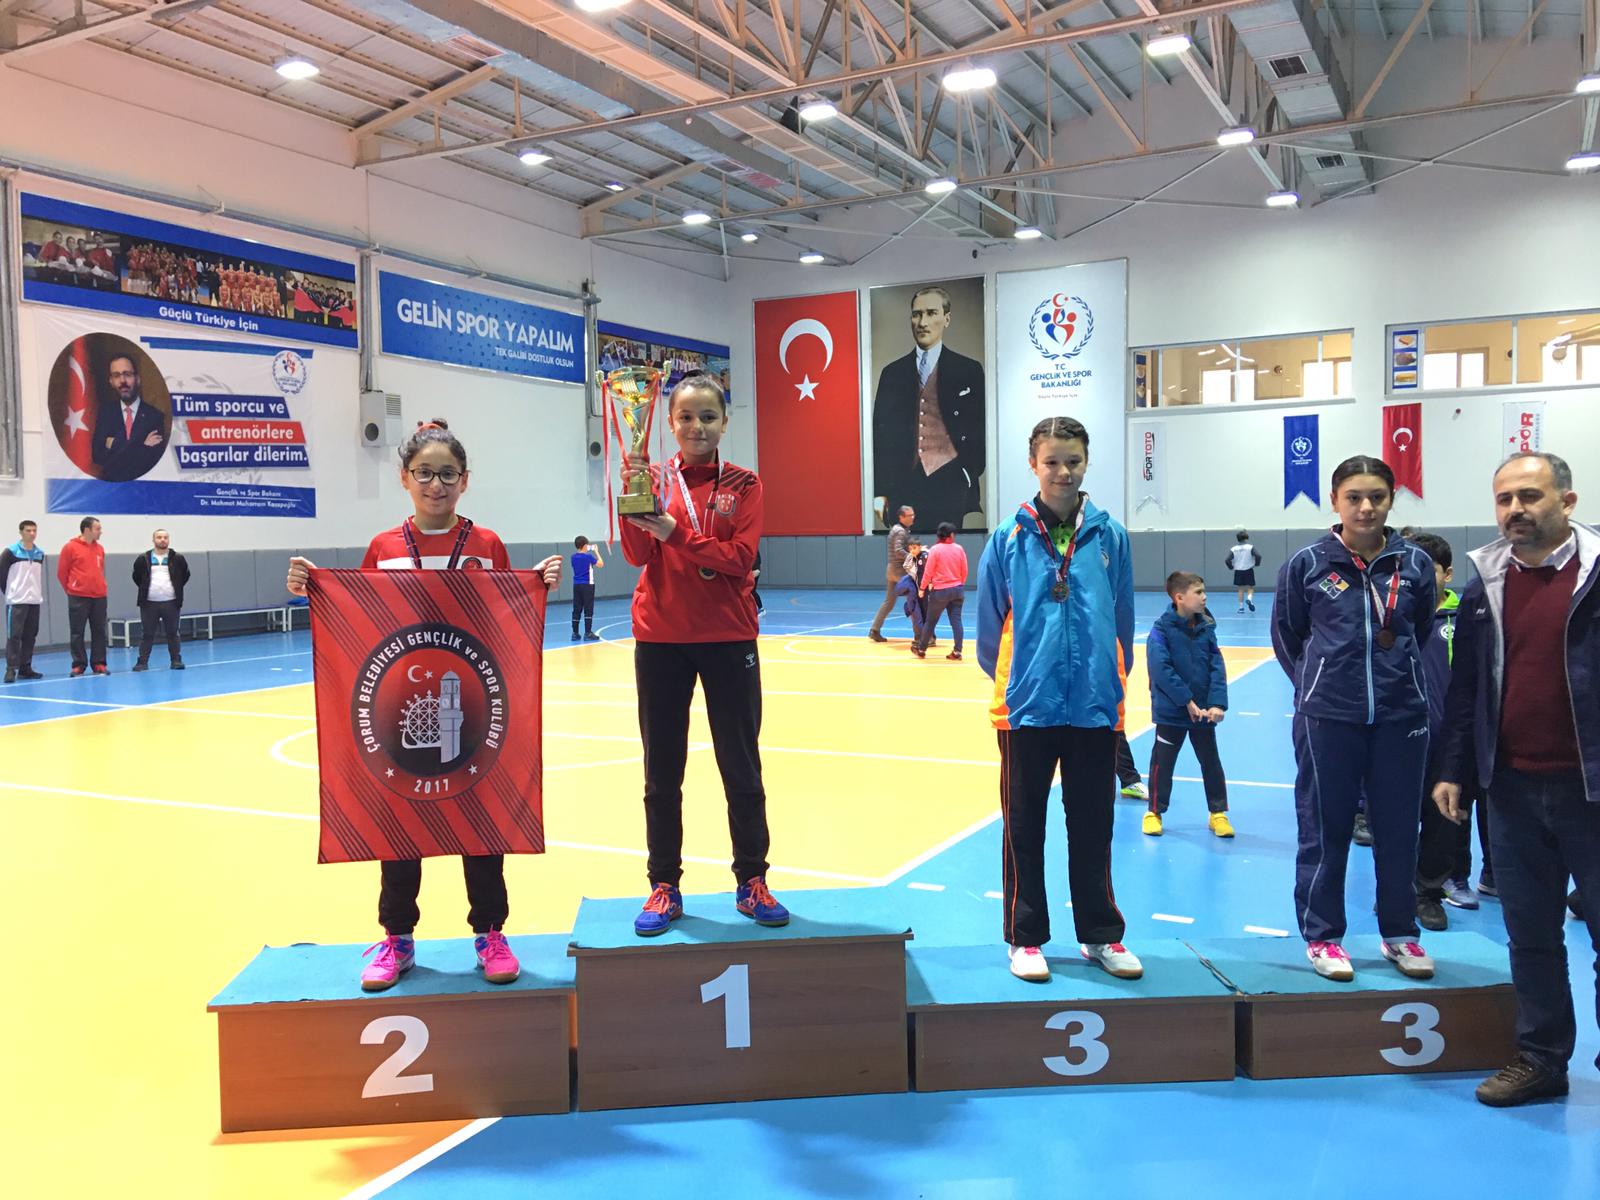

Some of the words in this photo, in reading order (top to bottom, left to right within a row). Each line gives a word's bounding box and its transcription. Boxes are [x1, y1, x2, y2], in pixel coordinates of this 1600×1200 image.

[159, 306, 192, 321] Güçlü
[195, 312, 236, 329] Türkiye
[239, 317, 259, 332] İçin
[397, 298, 452, 331] GELİN
[456, 310, 500, 340] SPOR
[504, 320, 574, 353] YAPALIM
[555, 357, 574, 368] OLSUN
[1062, 371, 1072, 379] VE
[1073, 369, 1092, 378] SPOR
[1041, 379, 1081, 389] BAKANLIĞI
[172, 395, 209, 412] Tüm
[215, 400, 265, 416] sporcu
[269, 402, 285, 414] ve
[201, 423, 294, 440] antrenörlere
[1520, 412, 1533, 454] POR
[180, 446, 249, 467] başarılar
[254, 446, 308, 462] dilerim.
[407, 631, 463, 650] GENÇLİK
[465, 646, 478, 660] ve
[359, 636, 405, 703] BELEDİYESİ
[478, 660, 500, 694] SPOR
[358, 707, 381, 753] ÇORUM
[414, 778, 449, 794] 2017
[700, 964, 751, 1049] 1
[1042, 1010, 1110, 1077] 3
[1379, 1002, 1446, 1067] 3
[359, 1015, 435, 1099] 2
